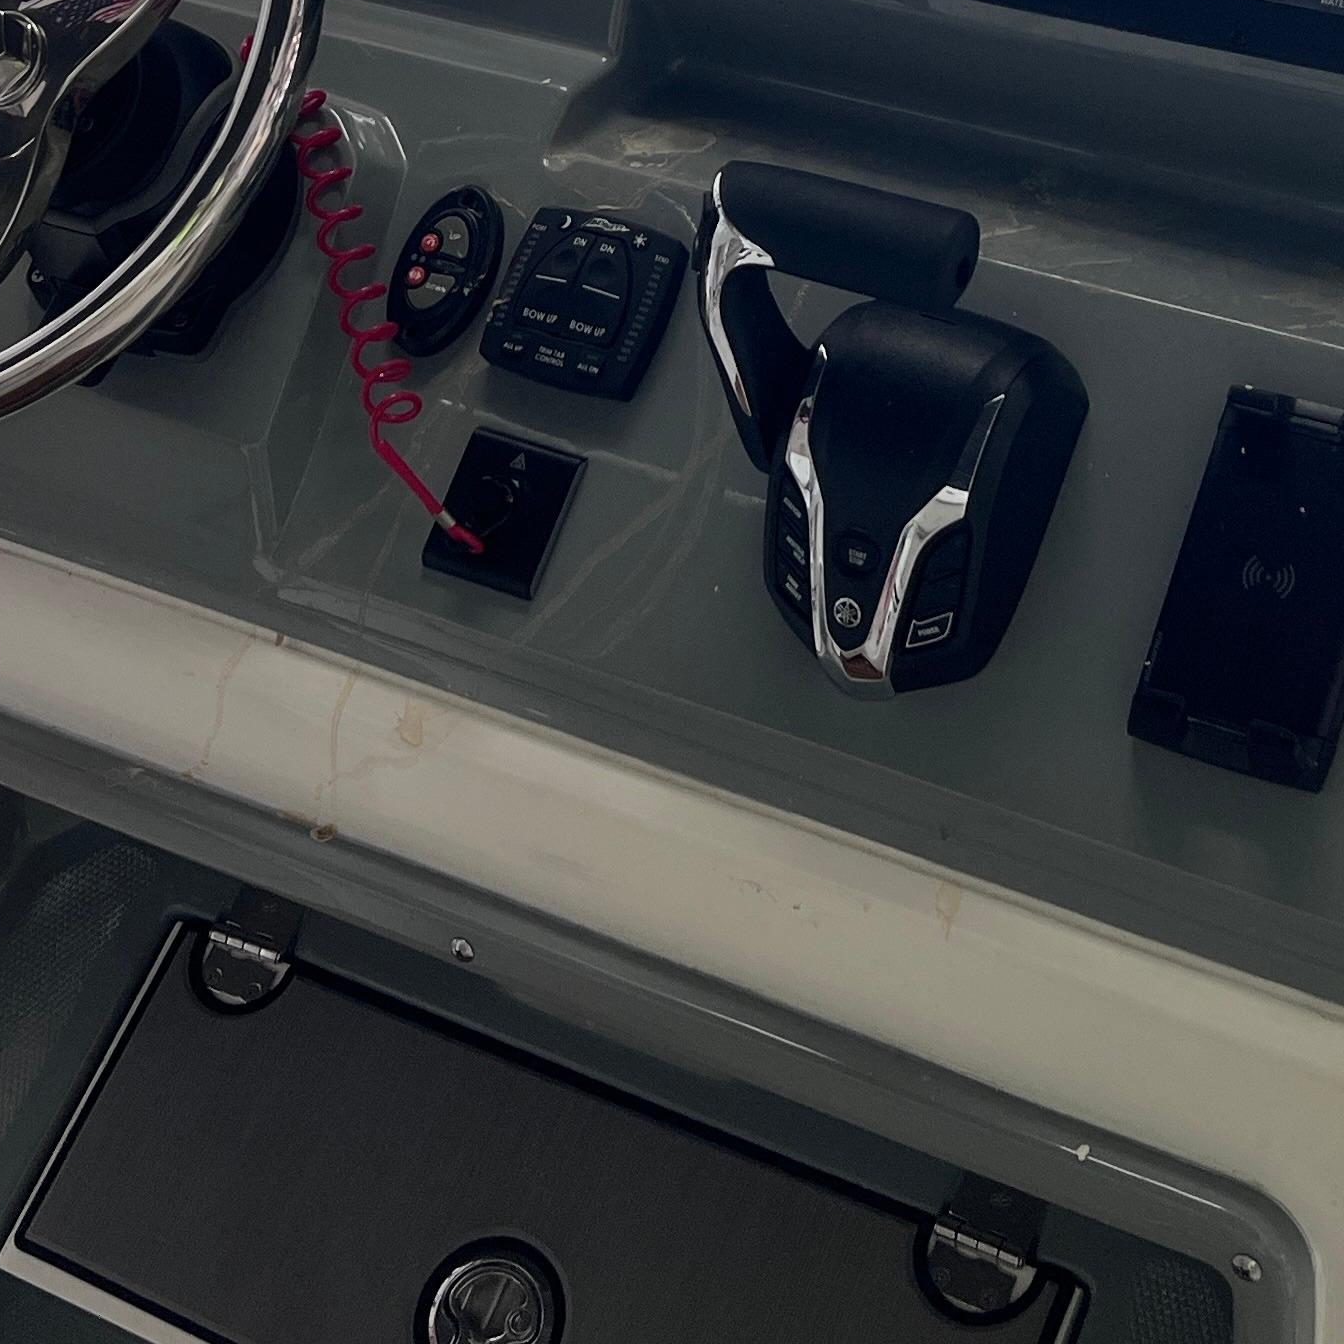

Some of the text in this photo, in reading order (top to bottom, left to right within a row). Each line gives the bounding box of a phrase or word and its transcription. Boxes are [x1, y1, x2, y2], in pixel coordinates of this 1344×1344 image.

[573, 236, 588, 247] DN
[599, 243, 616, 255] DN
[522, 306, 559, 325] BOW UP
[569, 318, 607, 338] BOW UP
